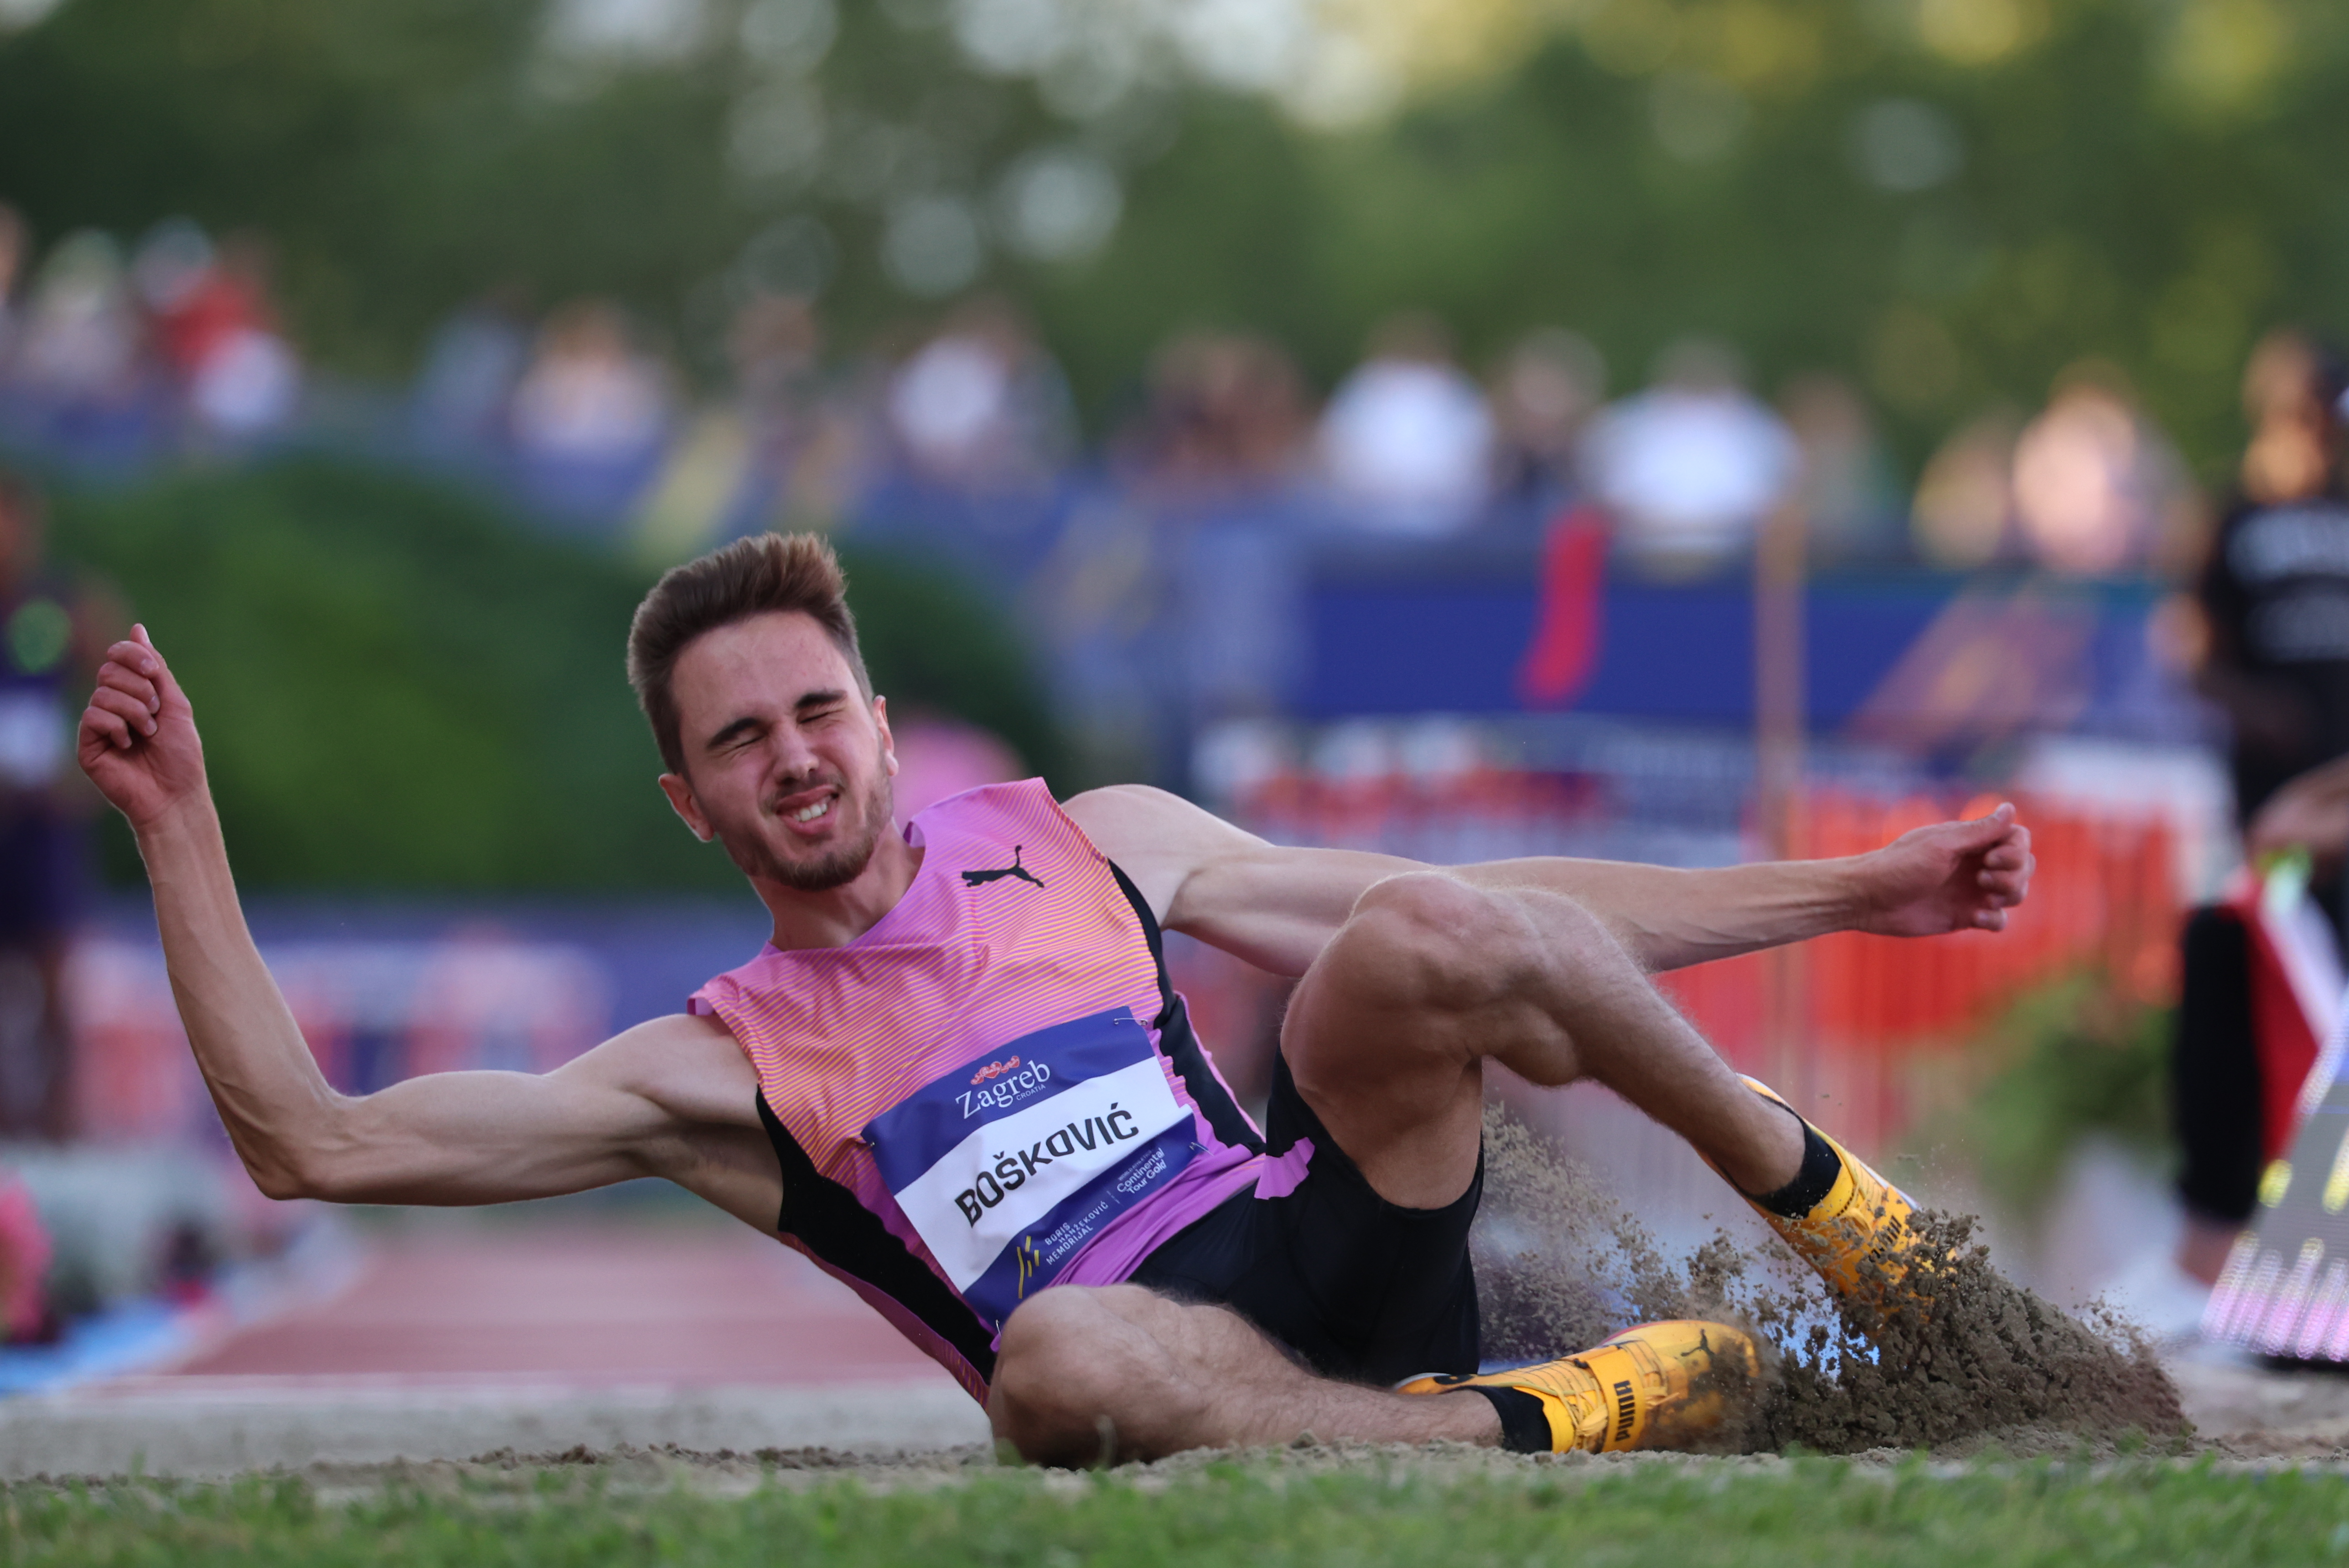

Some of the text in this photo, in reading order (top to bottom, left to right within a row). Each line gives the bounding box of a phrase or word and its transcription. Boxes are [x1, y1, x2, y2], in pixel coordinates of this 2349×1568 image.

[955, 1060, 1050, 1119] Zagreb
[1016, 1084, 1046, 1101] CROATIA
[954, 1102, 1139, 1228] BOŠKOVIĆ
[1117, 1147, 1165, 1192] Continental
[1127, 1159, 1167, 1194] Tour Gold
[1045, 1222, 1071, 1245] BORIS
[1059, 1201, 1109, 1243] HANŽEKOVIĆ
[1046, 1225, 1093, 1265] MEMORIJAL
[1614, 1380, 1635, 1442] PUMA
